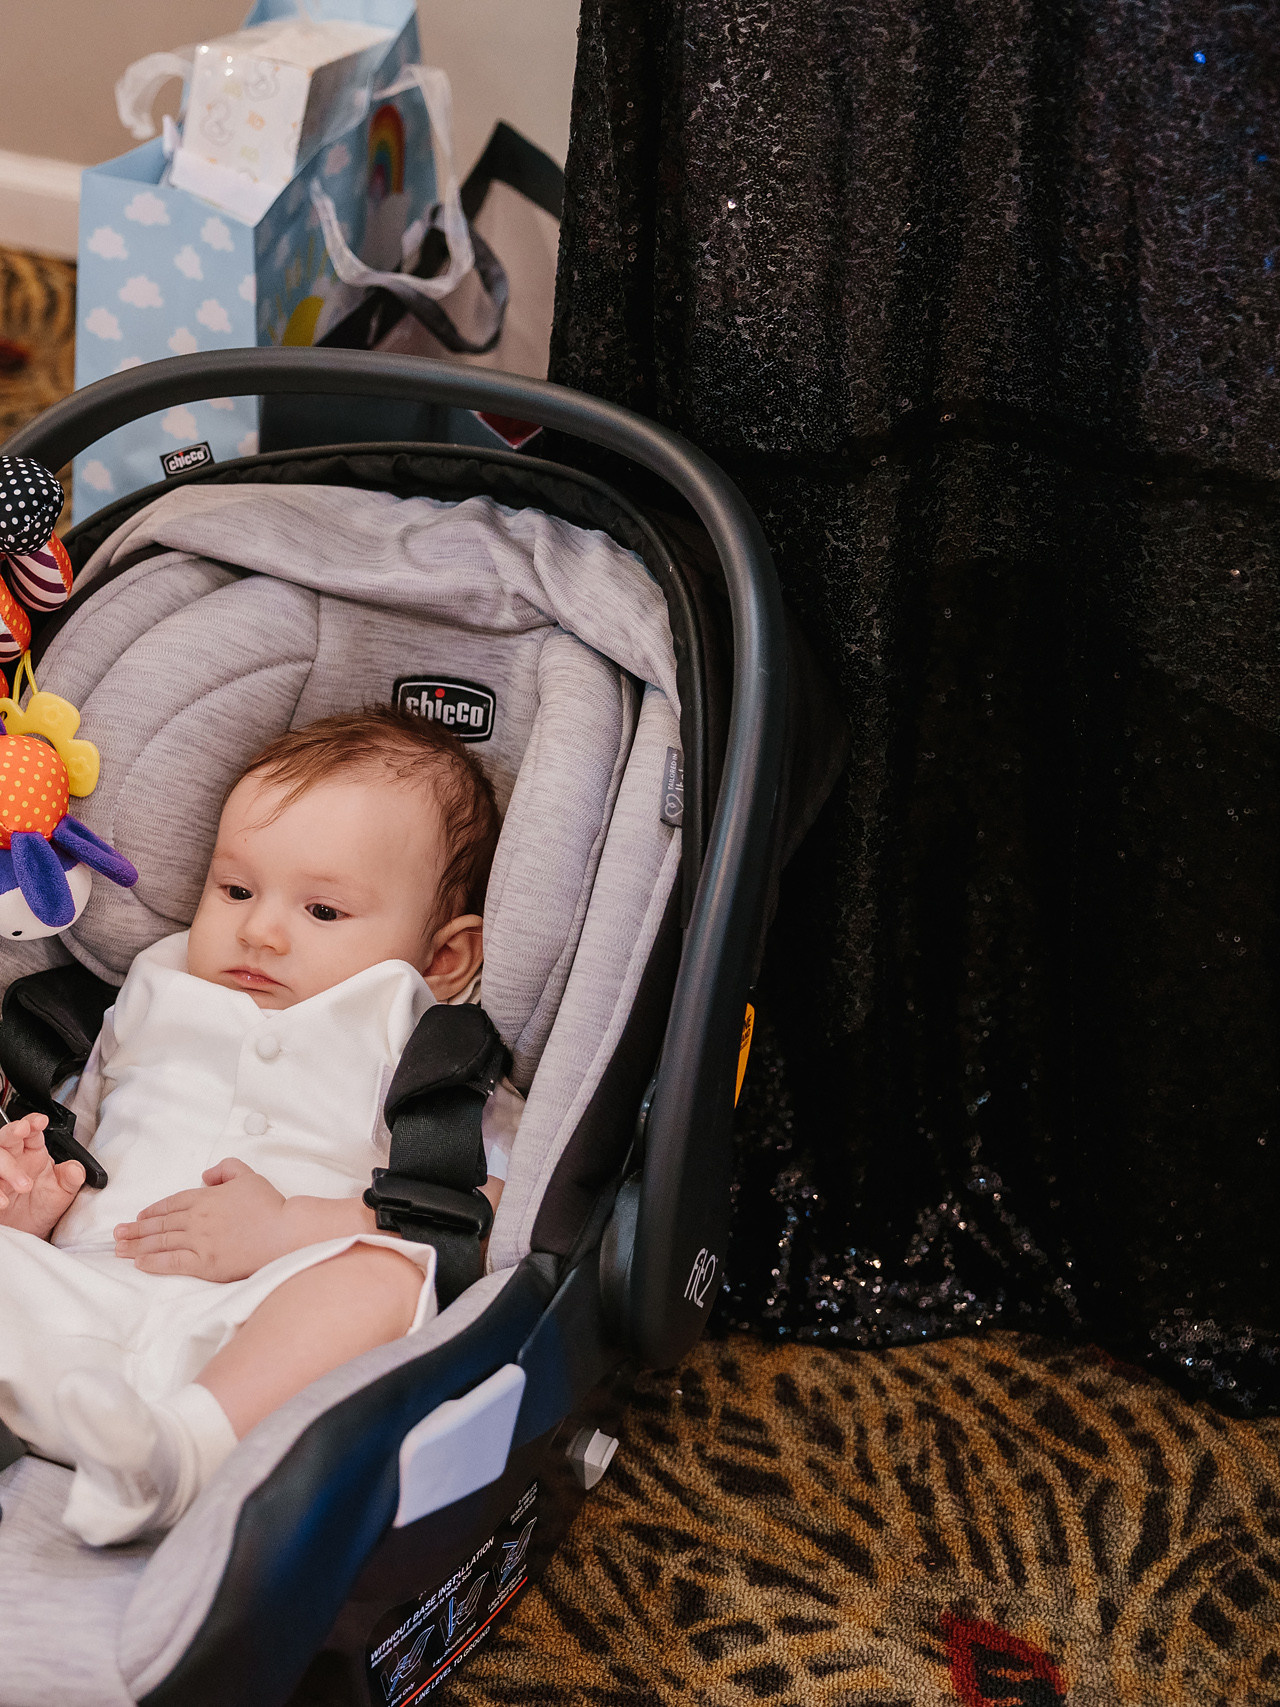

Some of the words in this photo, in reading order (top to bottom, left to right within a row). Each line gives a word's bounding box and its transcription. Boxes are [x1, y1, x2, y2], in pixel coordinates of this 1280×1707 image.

[168, 451, 205, 471] chicco
[405, 687, 484, 728] chicco
[672, 753, 678, 761] IN
[668, 761, 677, 790] TAILORED
[370, 1617, 412, 1662] WITHOUT
[413, 1594, 437, 1623] BASE
[438, 1536, 495, 1599] INSTALLATION
[415, 1685, 431, 1705] LINE
[431, 1667, 452, 1690] LEVEL
[454, 1655, 463, 1667] TO
[463, 1626, 490, 1657] GROUND
